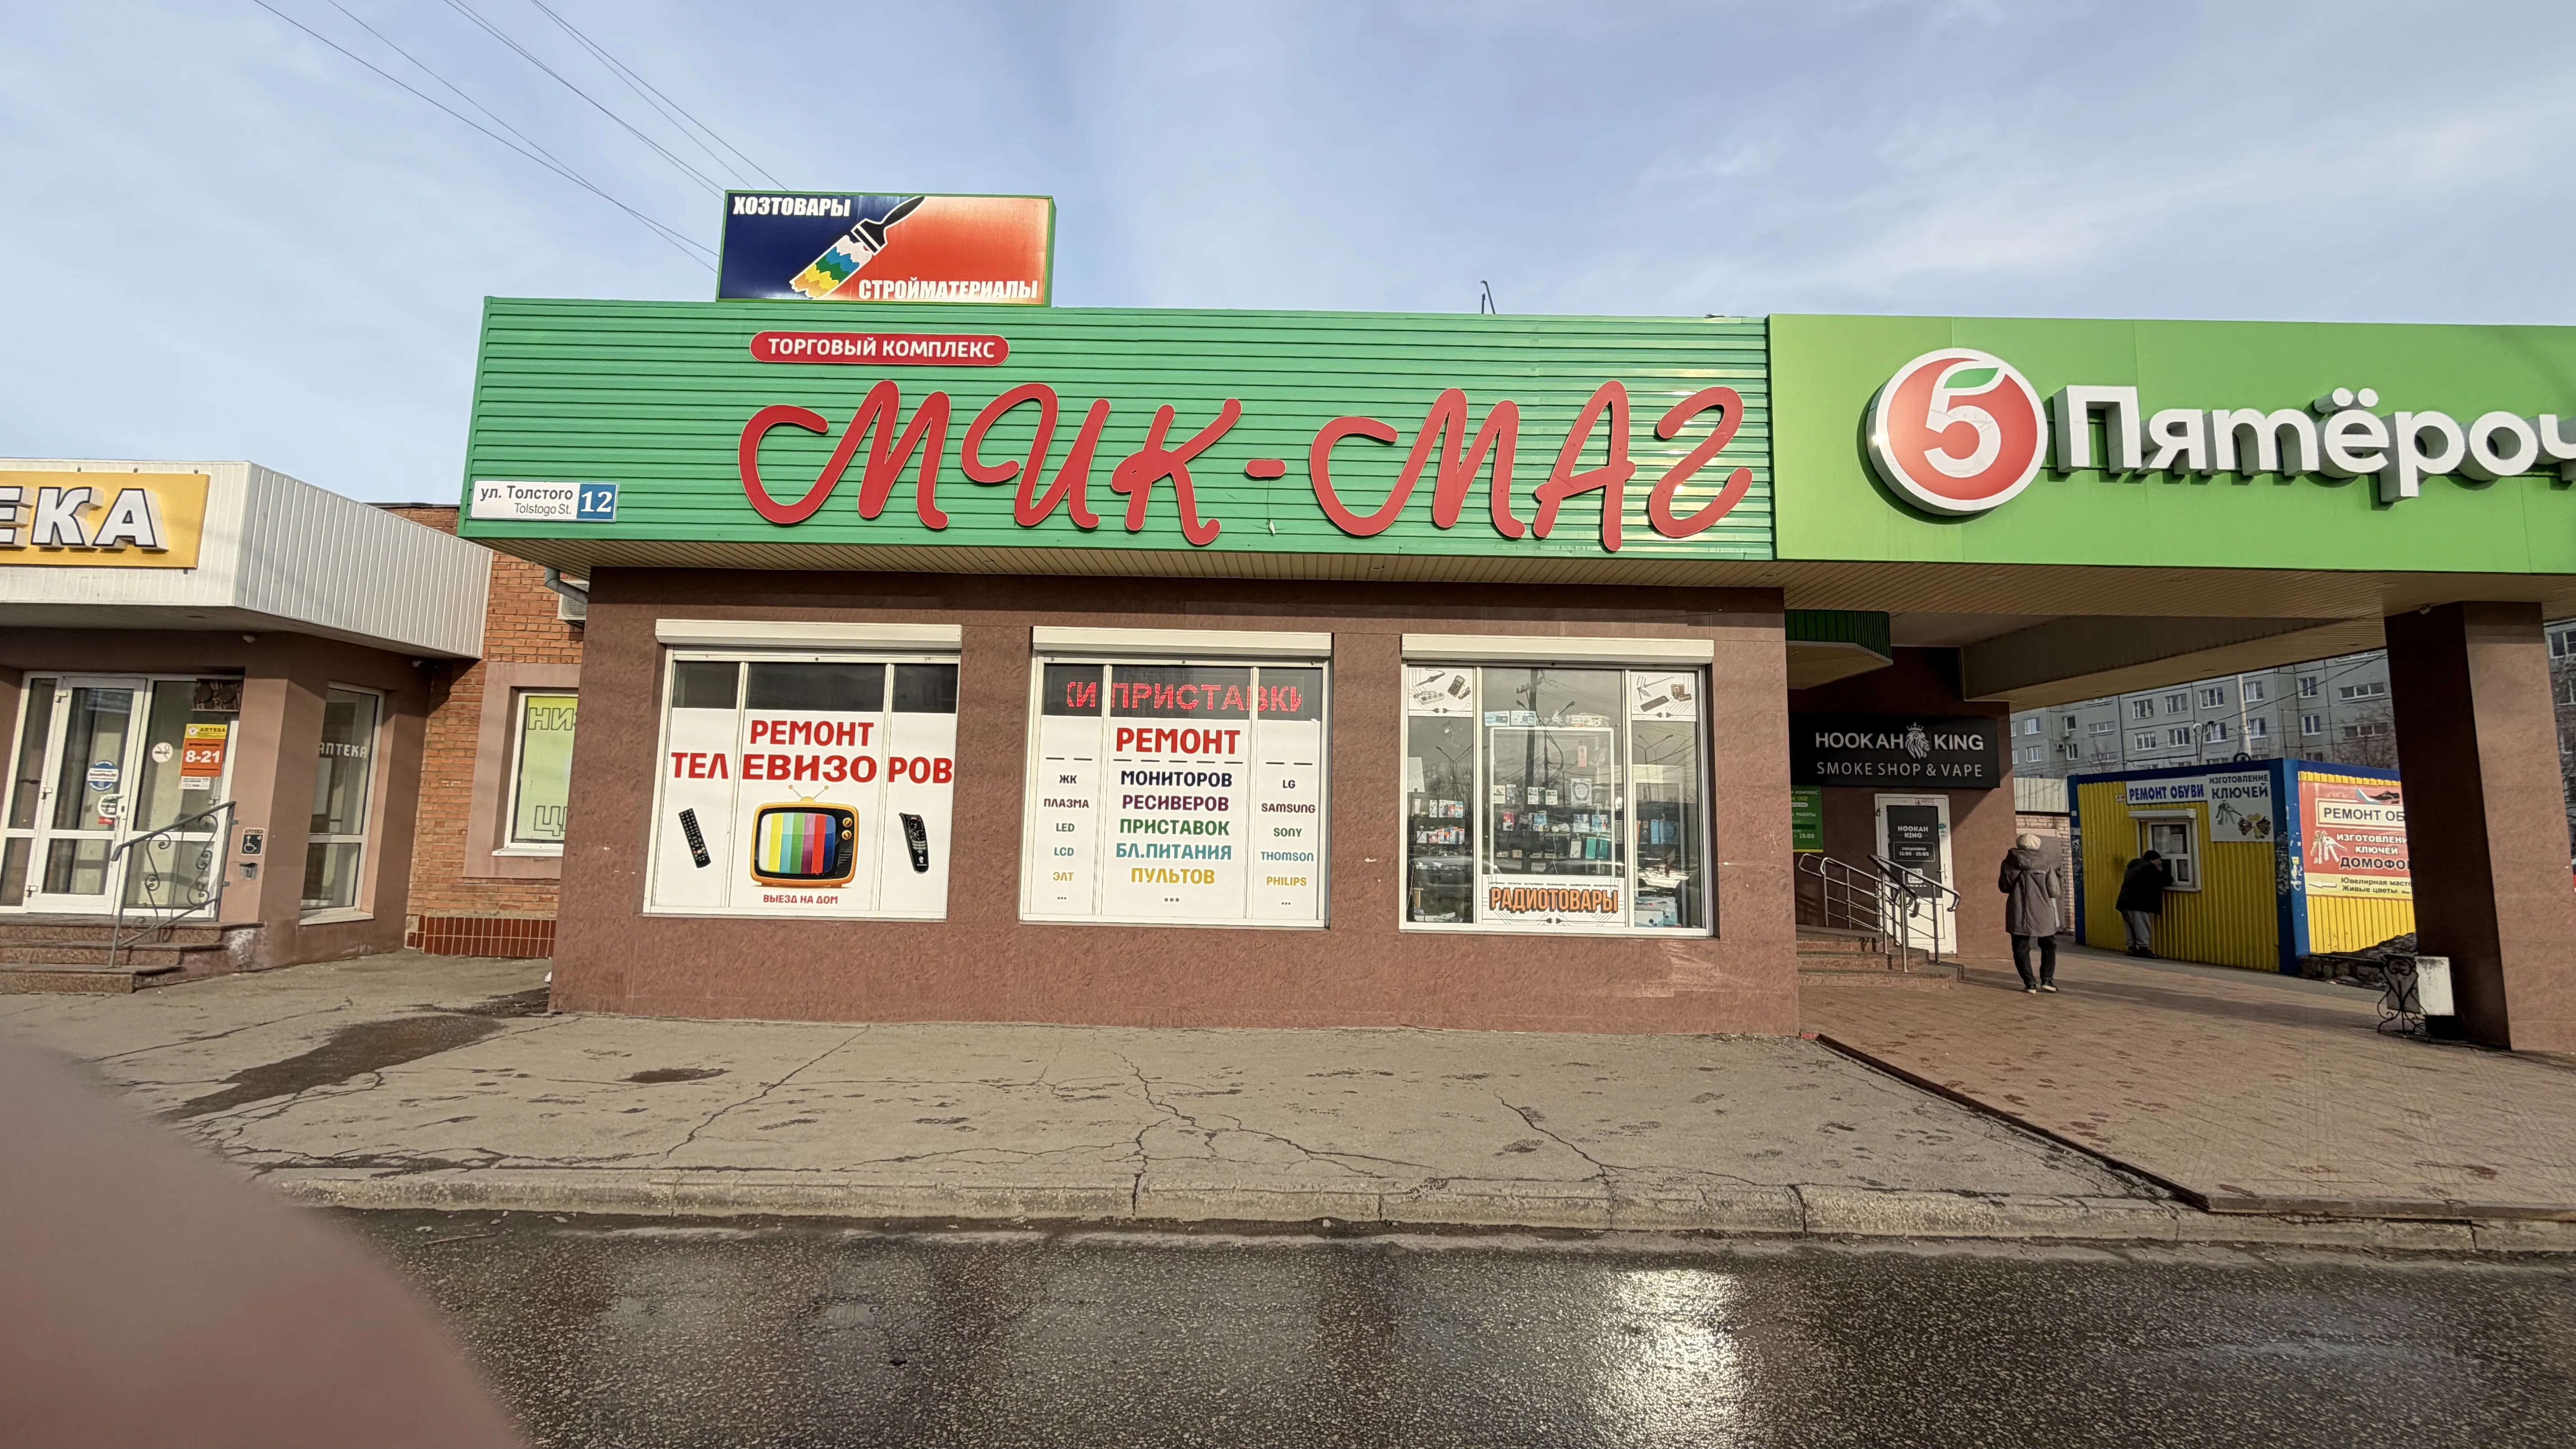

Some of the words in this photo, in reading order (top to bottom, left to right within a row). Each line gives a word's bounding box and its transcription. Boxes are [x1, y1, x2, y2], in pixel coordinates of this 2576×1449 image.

[733, 196, 851, 217] ХОЗТОВАРЫ
[858, 276, 1038, 299] СТРОЙМАТЕРИАЛЫ
[768, 337, 876, 356] ТОРГОВЫЙ
[882, 340, 995, 359] КОМПЛЕКС
[480, 488, 501, 502] ул.
[506, 485, 573, 500] Толстого
[580, 491, 613, 513] 12
[515, 502, 557, 517] Tolstogo
[558, 503, 571, 515] St.
[527, 707, 577, 731] НИ
[750, 720, 874, 746] РЕМОНТ
[1116, 727, 1241, 754] РЕМОНТ
[1815, 732, 1904, 750] HOOKAH
[1934, 734, 1984, 751] KING
[185, 750, 221, 763] 8-21
[319, 741, 368, 758] АПТЕКА
[1817, 762, 1873, 775] SMOKE
[1878, 763, 1921, 776] SHOP
[1926, 763, 1937, 777] &
[1941, 764, 1983, 777] VAPE
[1059, 774, 1077, 784] ЖК
[1120, 770, 1232, 787] МОНИТОРОВ
[1282, 780, 1296, 789] LG
[2209, 774, 2268, 784] ИЗГОТОВЛЕНИЕ
[2129, 786, 2167, 801] РЕМОНТ
[2170, 784, 2204, 799] ОБУВИ
[2212, 782, 2269, 799] КЛЮЧЕЙ
[1043, 798, 1090, 809] ПЛАЗМА
[1122, 794, 1229, 812] РЕСИВЕРОВ
[534, 805, 567, 837] Ц
[2324, 807, 2381, 821] РЕМОНТ
[1056, 823, 1075, 833] LED
[1119, 818, 1230, 836] ПРИСТАВОК
[1273, 828, 1302, 838] SONY
[1054, 846, 1075, 857] LCD
[1116, 842, 1232, 860] БЛ.ПИТАНИЯ
[2340, 857, 2410, 869] ДОМОФО
[1053, 871, 1074, 882] ЭЛТ
[1131, 867, 1215, 885] ПУЛЬТОВ
[1266, 876, 1307, 887] PHILIPS
[2341, 877, 2387, 886] Ювелирная
[763, 894, 797, 904] ВЫЕЗД
[800, 895, 814, 904] НА
[816, 895, 838, 905] ДОМ
[1490, 887, 1618, 913] РАДИОТОВАРЫ
